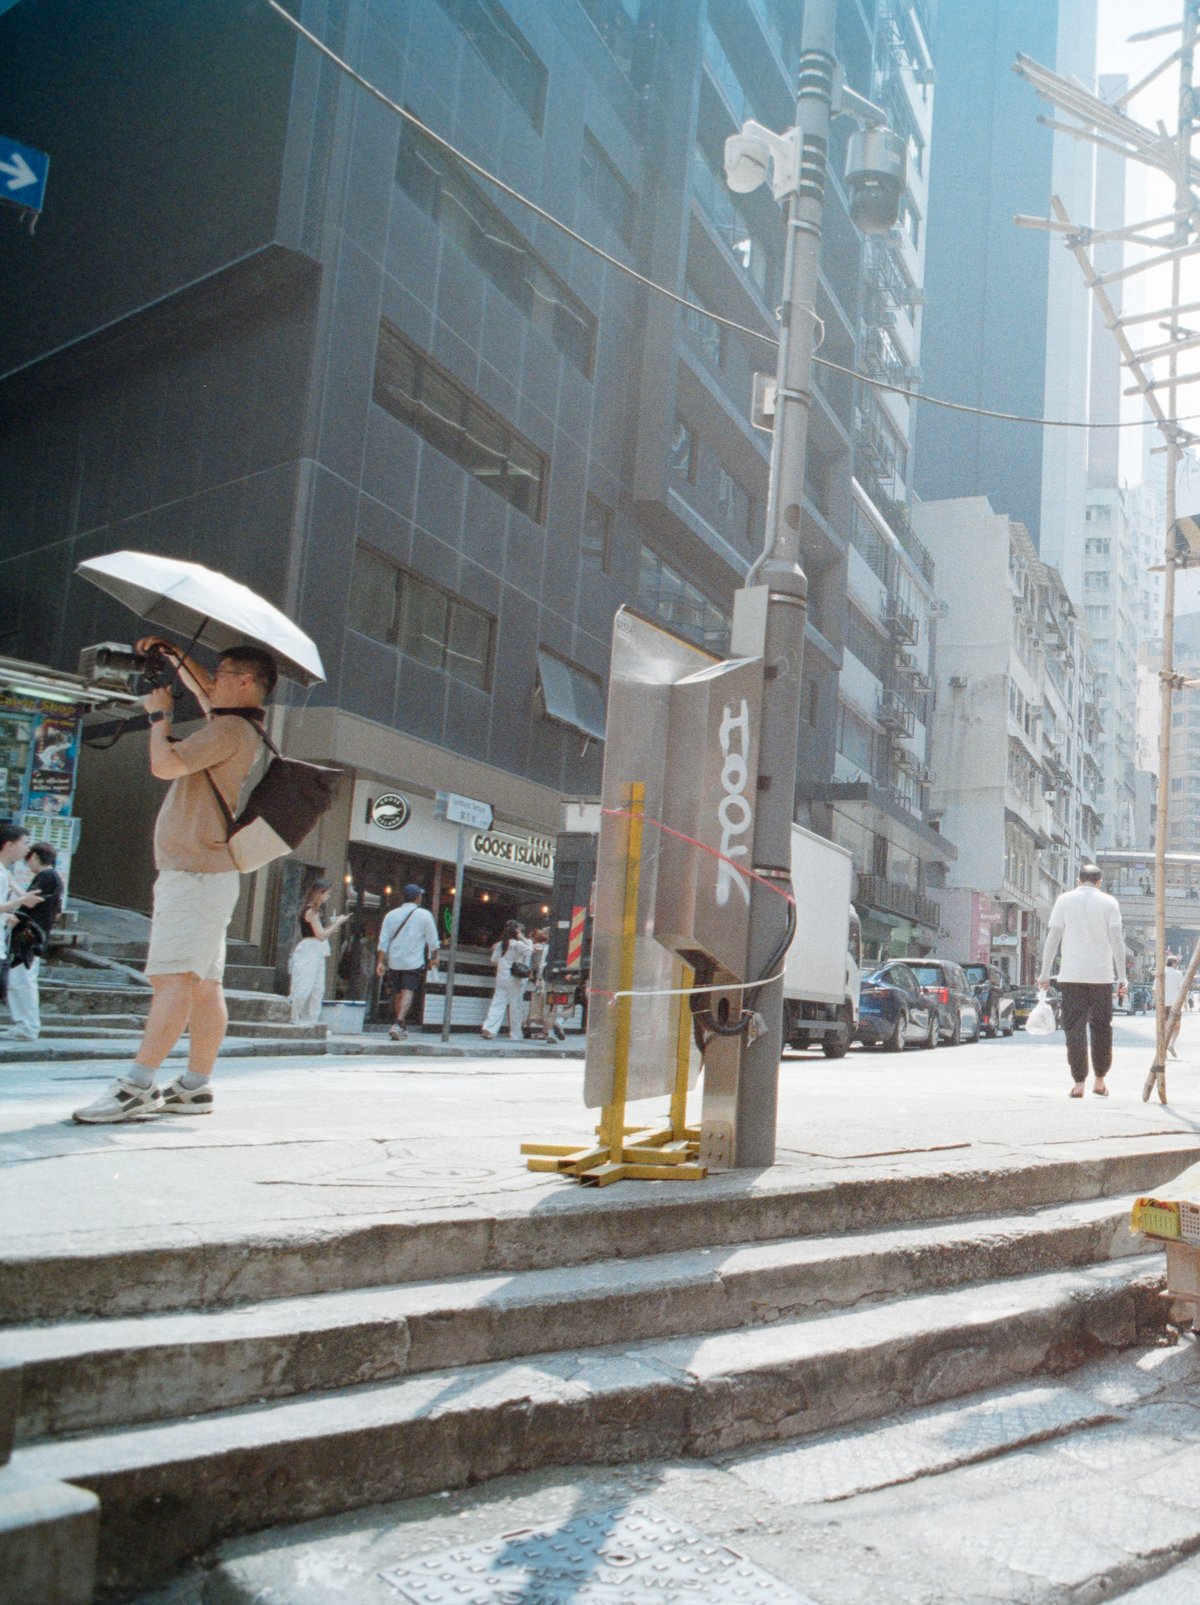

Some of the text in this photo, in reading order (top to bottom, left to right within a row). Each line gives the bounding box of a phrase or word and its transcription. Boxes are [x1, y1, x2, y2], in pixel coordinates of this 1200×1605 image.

[41, 701, 76, 714] Shop
[474, 834, 513, 860] GOOSE
[514, 844, 550, 869] ISLAND
